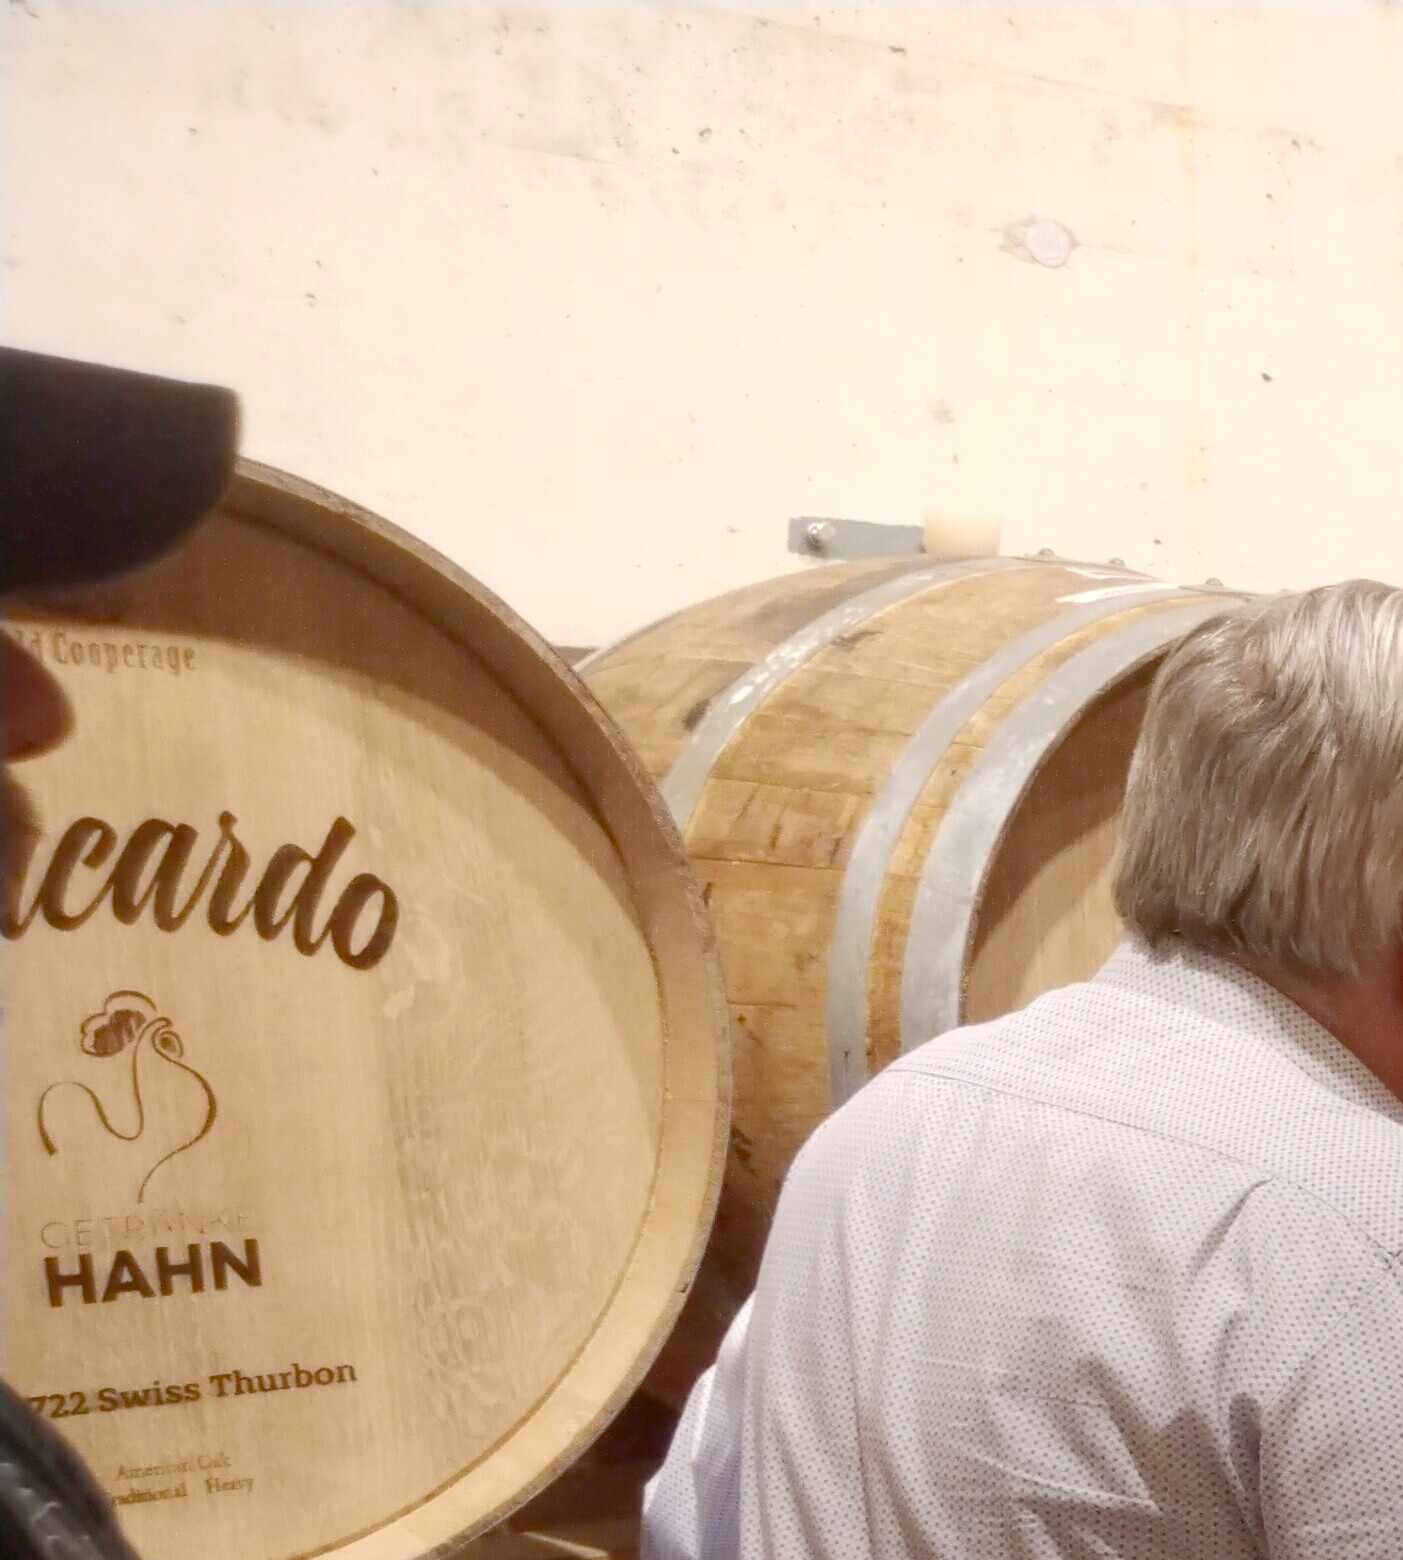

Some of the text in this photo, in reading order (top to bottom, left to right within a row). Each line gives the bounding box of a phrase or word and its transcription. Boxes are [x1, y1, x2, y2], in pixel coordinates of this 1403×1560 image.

[52, 631, 196, 676] Cooperage
[0, 810, 400, 970] cardo
[44, 1238, 262, 1308] HAHN
[98, 1380, 201, 1413] Swiss
[208, 1363, 358, 1399] Thurbon
